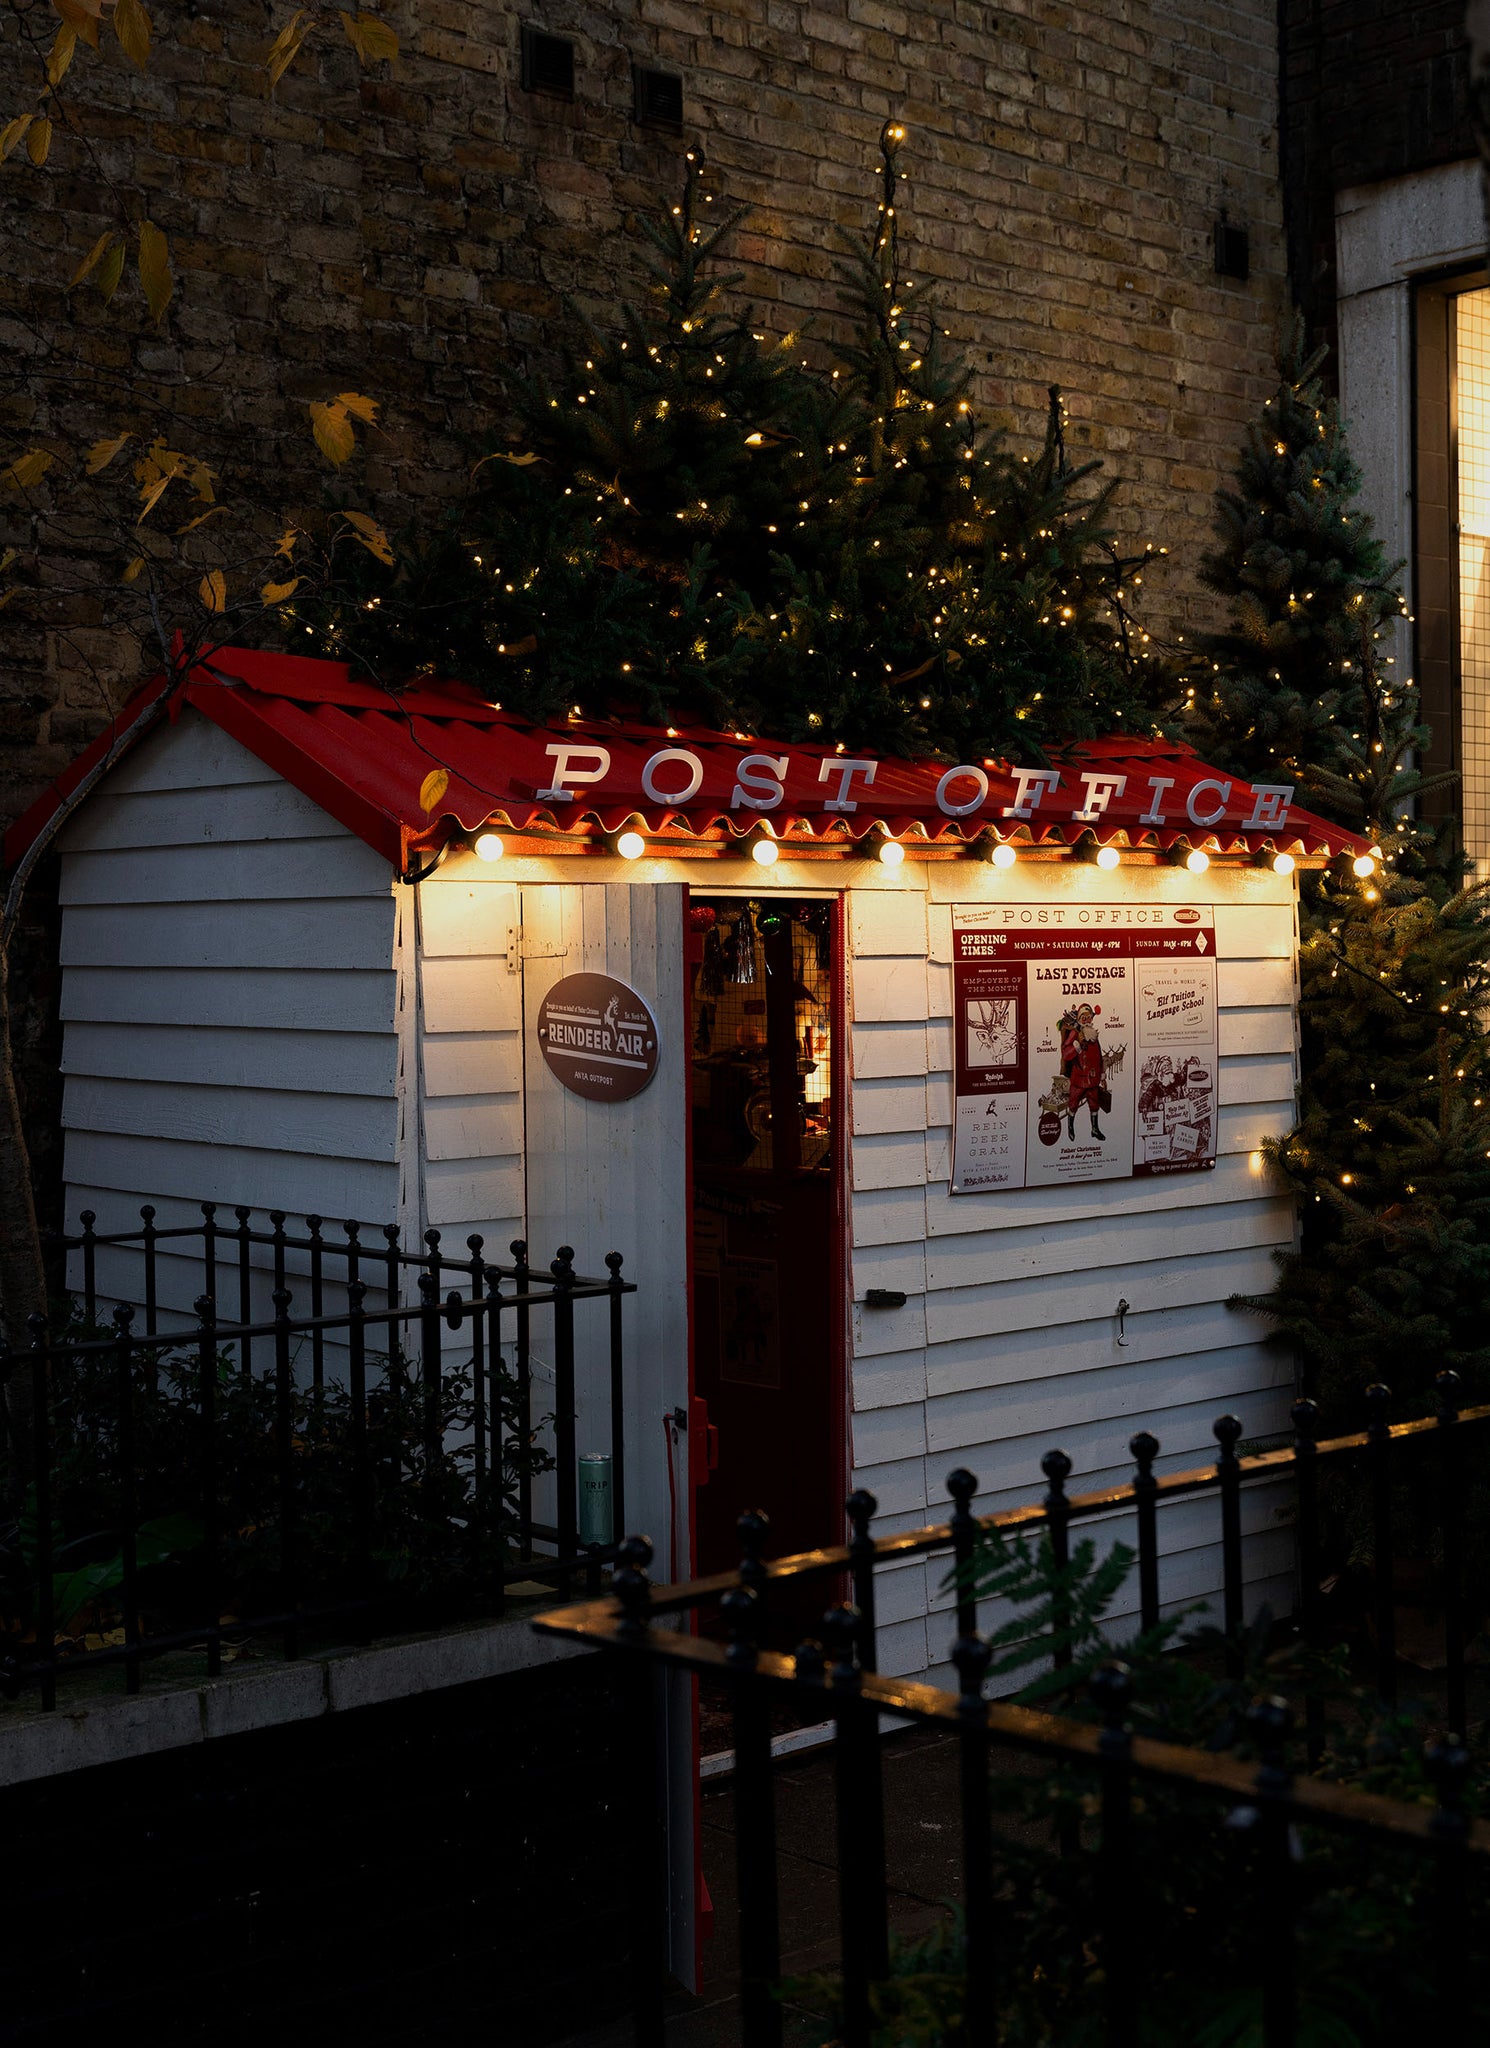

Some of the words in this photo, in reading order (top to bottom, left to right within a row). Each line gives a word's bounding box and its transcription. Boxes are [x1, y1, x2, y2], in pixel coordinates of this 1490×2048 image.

[535, 743, 878, 812] POST
[935, 764, 1295, 830] OFFICE
[1002, 910, 1065, 923] POST
[1078, 910, 1164, 923] OFFICE
[960, 934, 1007, 945] OPENING
[1014, 941, 1045, 949] MONDAY
[1052, 941, 1089, 949] SATURDAY
[961, 946, 997, 956] TIMES:
[1036, 967, 1069, 980] LAST
[1071, 966, 1126, 980] POSTAGE
[963, 977, 1010, 985] EMPLOYEE
[967, 985, 985, 993] THE
[1062, 982, 1102, 996] DATES
[1156, 995, 1170, 1008] Elf
[1170, 990, 1196, 1004] Tuition
[1146, 1005, 1180, 1021] Language
[1181, 996, 1205, 1012] School
[549, 1022, 612, 1052] REINDEER
[616, 1032, 644, 1057] AIR
[590, 1073, 614, 1086] OUTPOST
[972, 1121, 1008, 1132] REIN
[971, 1133, 1009, 1145] DEER
[969, 1146, 1008, 1157] GRAM
[584, 1480, 608, 1490] TRIP
